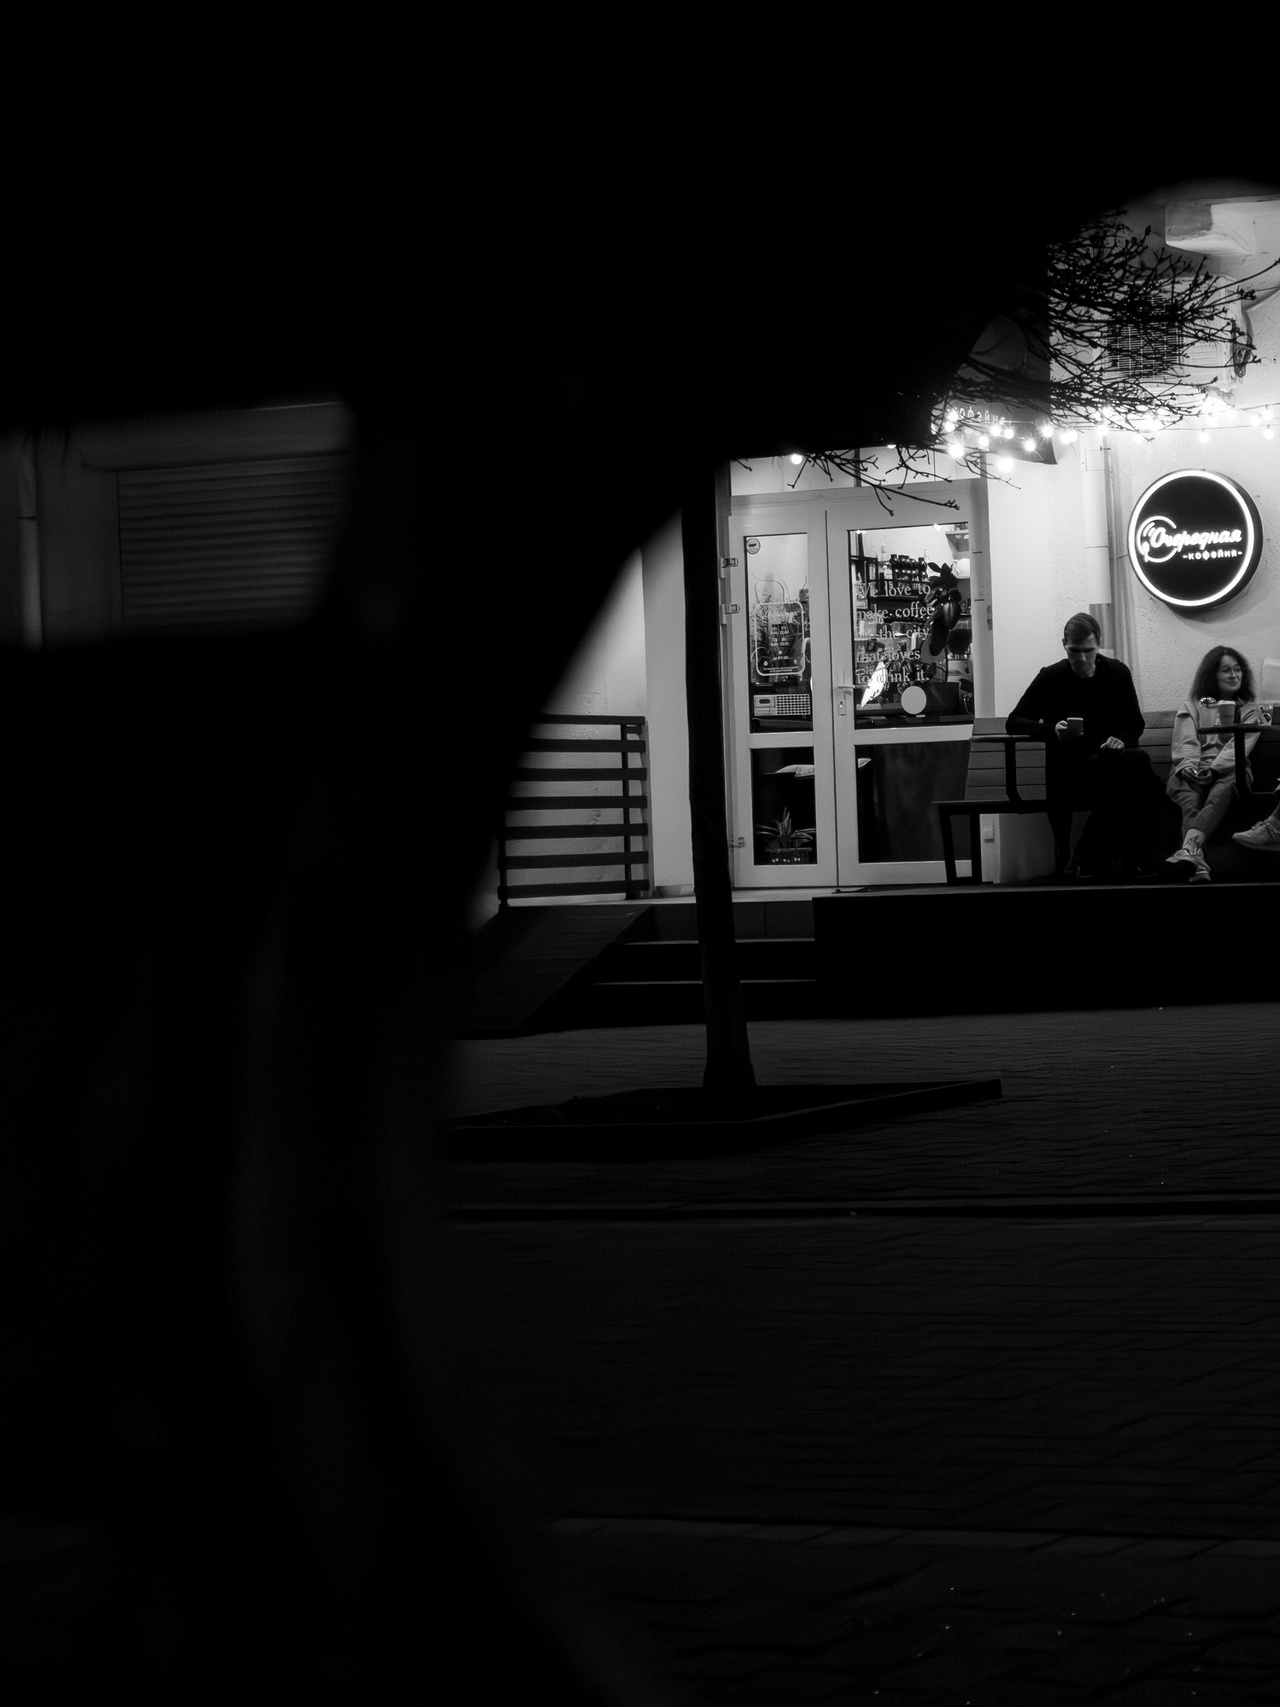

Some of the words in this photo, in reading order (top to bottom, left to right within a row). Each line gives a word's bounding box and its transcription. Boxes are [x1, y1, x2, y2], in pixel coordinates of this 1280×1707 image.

[1150, 526, 1242, 552] Очередная
[884, 580, 912, 597] love
[918, 583, 931, 595] to
[895, 601, 934, 617] coffee
[906, 624, 930, 641] city
